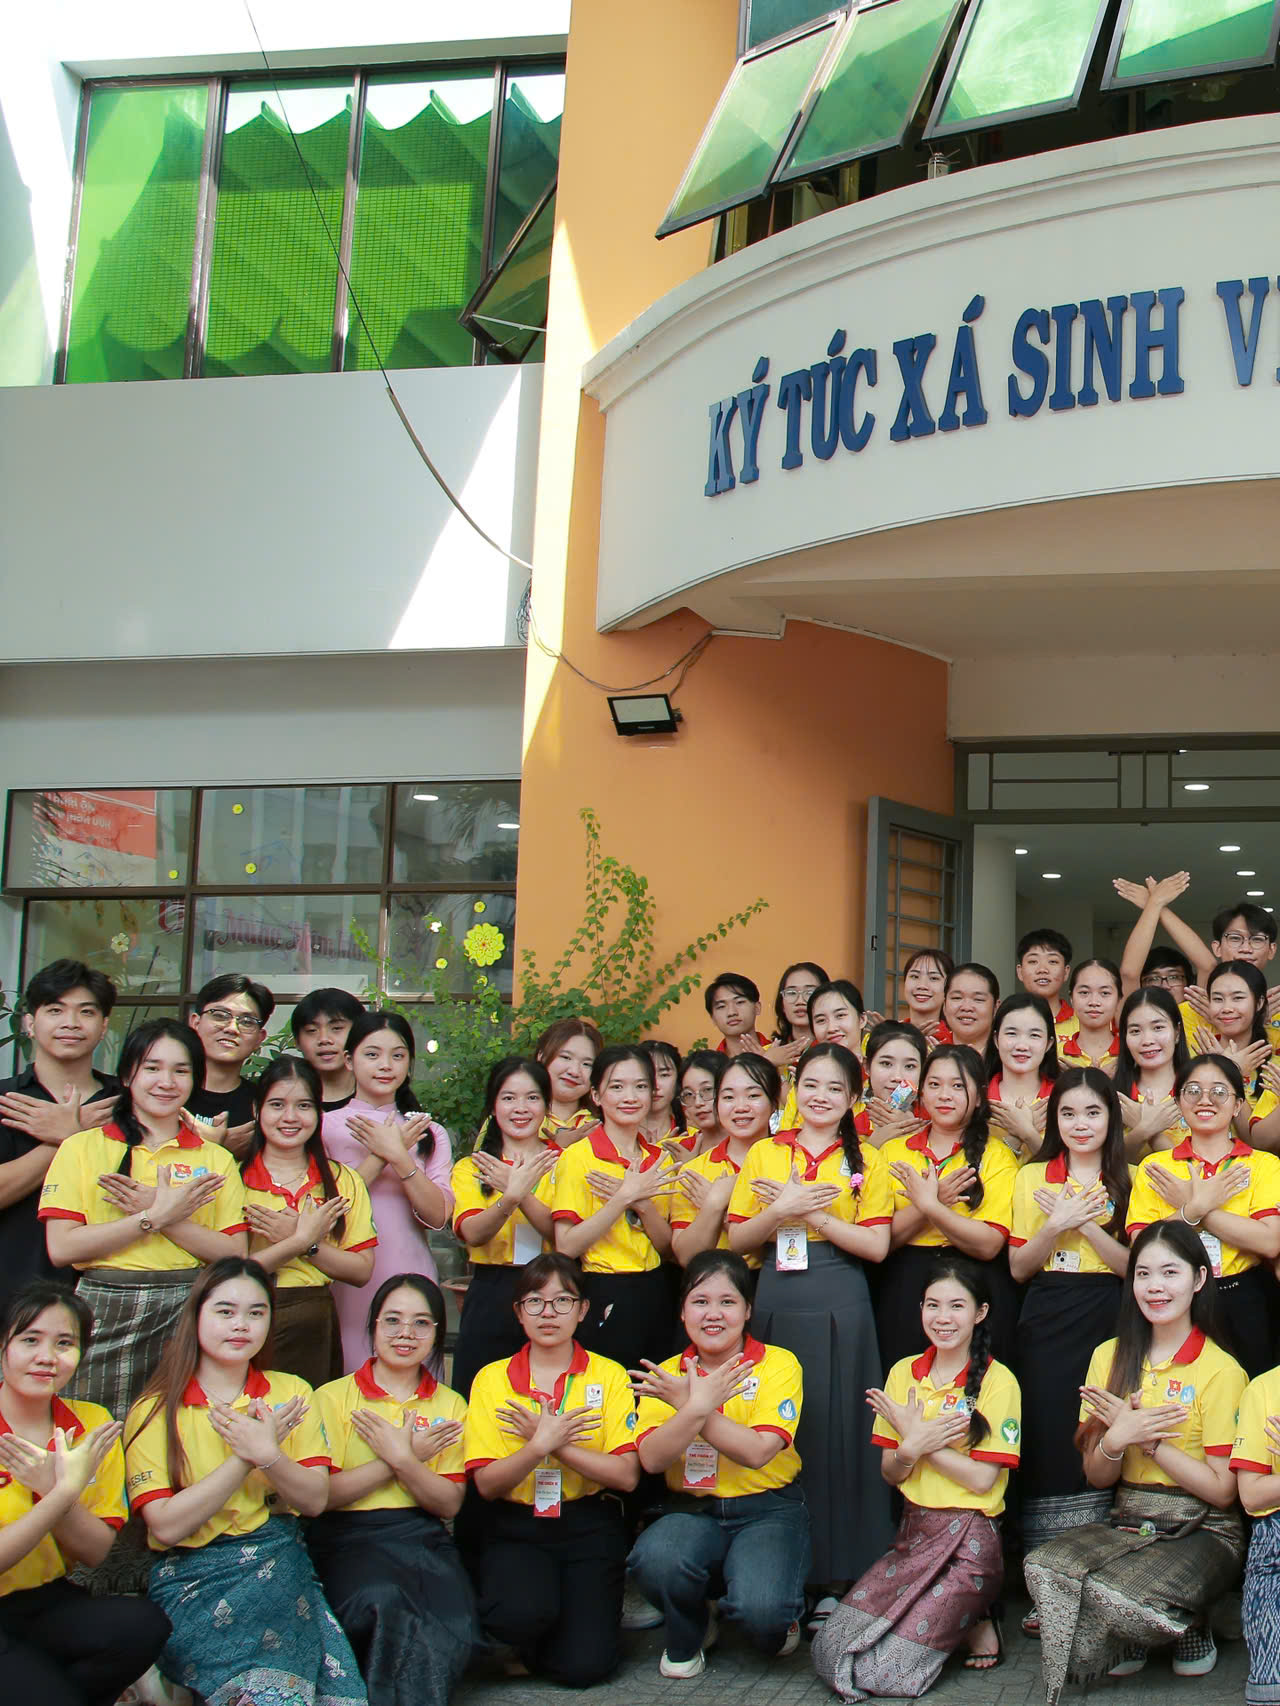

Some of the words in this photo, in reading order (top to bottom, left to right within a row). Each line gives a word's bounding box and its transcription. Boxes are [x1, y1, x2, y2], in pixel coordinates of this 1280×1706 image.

[703, 356, 770, 497] KÝ
[776, 328, 876, 470] TÚC
[889, 295, 988, 441] XÁ
[1007, 287, 1185, 417] SINH
